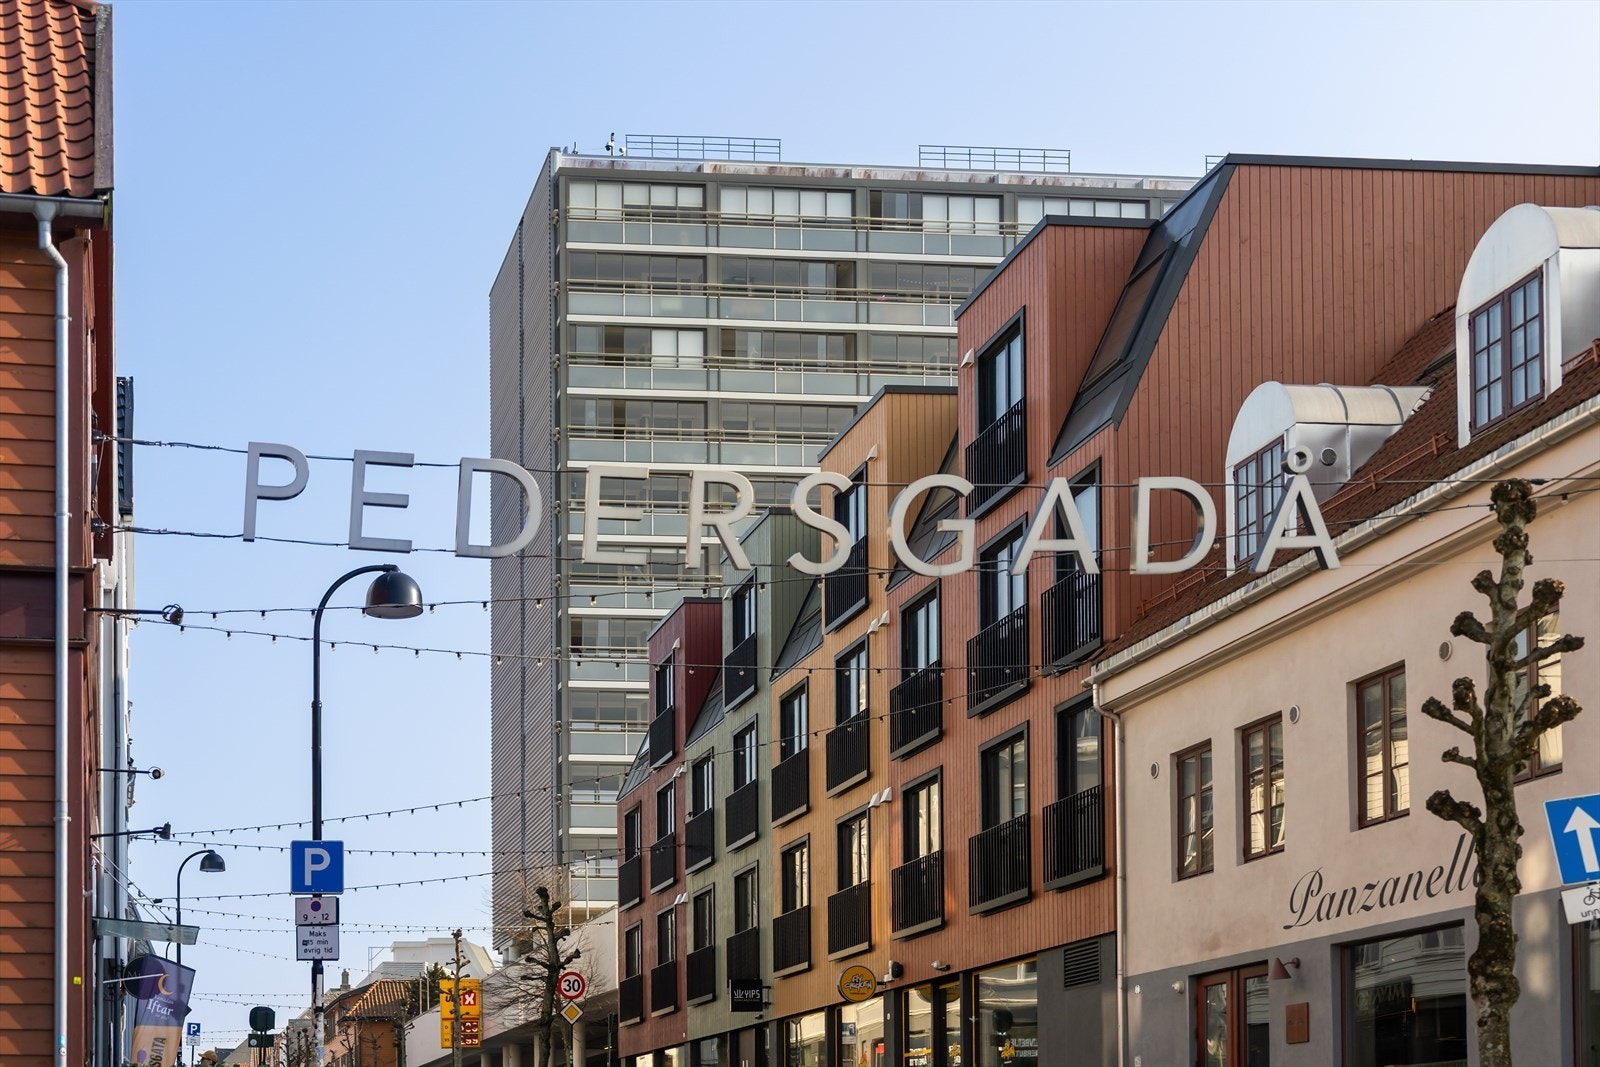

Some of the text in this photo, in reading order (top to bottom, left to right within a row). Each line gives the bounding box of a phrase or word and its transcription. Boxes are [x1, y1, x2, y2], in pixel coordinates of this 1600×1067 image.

[243, 441, 1341, 577] PEDERSGADÅ
[304, 848, 331, 886] P
[303, 913, 309, 921] 9
[321, 913, 330, 921] 12
[316, 938, 329, 946] min
[563, 978, 580, 992] 30
[146, 998, 174, 1016] Iftar
[190, 1024, 198, 1035] P
